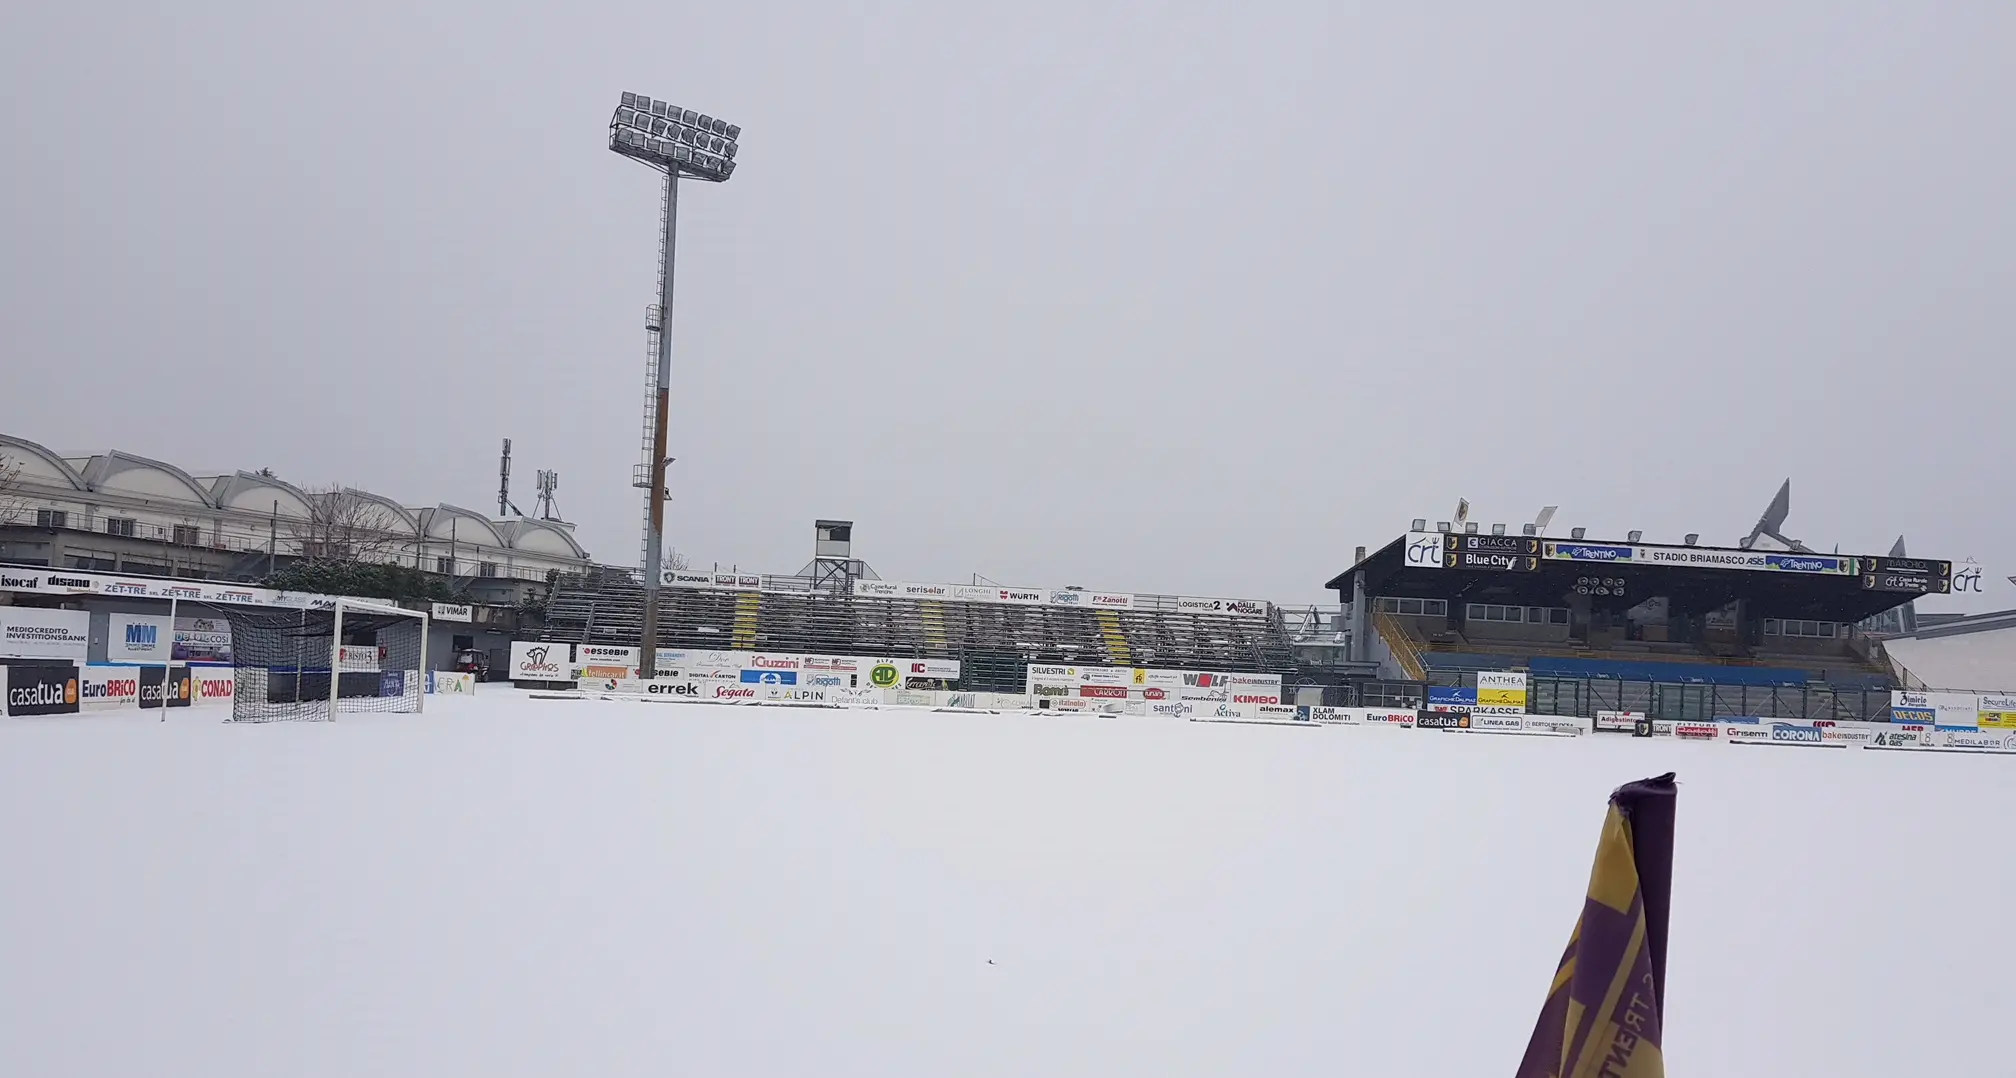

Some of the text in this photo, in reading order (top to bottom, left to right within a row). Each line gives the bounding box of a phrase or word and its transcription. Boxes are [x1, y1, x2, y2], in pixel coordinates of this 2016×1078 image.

[1479, 538, 1517, 547] GIACCA
[1653, 552, 1745, 565] STADIO BRIAMASCO
[1, 575, 38, 589] isocaf
[48, 575, 90, 588] disano
[105, 584, 146, 595] ZET-TRE
[162, 588, 201, 599] ZET-TRE
[906, 585, 945, 594] serisolar
[216, 592, 253, 603] ZET-TRE
[1102, 595, 1128, 604] Zanotti
[1213, 601, 1221, 610] 2
[446, 606, 468, 616] VIMAR
[7, 626, 69, 635] MEDIOCREDITO
[6, 633, 87, 641] INVESTITIONSBANK
[752, 656, 799, 669] iGuzzini
[1032, 667, 1066, 675] SILVESTRI
[1479, 675, 1525, 686] ANTHEA
[10, 680, 64, 705] casatua
[82, 680, 136, 698] EuroBRiCO
[201, 680, 233, 697] CONAD
[648, 682, 698, 694] errek
[712, 685, 755, 699] Segata
[784, 691, 824, 700] ALPIN
[1233, 694, 1278, 704] KIMBO
[1213, 707, 1241, 718] Activa
[1450, 706, 1520, 714] SPARKASSE
[1312, 713, 1351, 721] DOLOMITI
[1366, 714, 1414, 723] EuroBRiCO
[1419, 717, 1458, 727] casatua
[1773, 729, 1820, 741] CORONA
[1889, 732, 1917, 740] atesina
